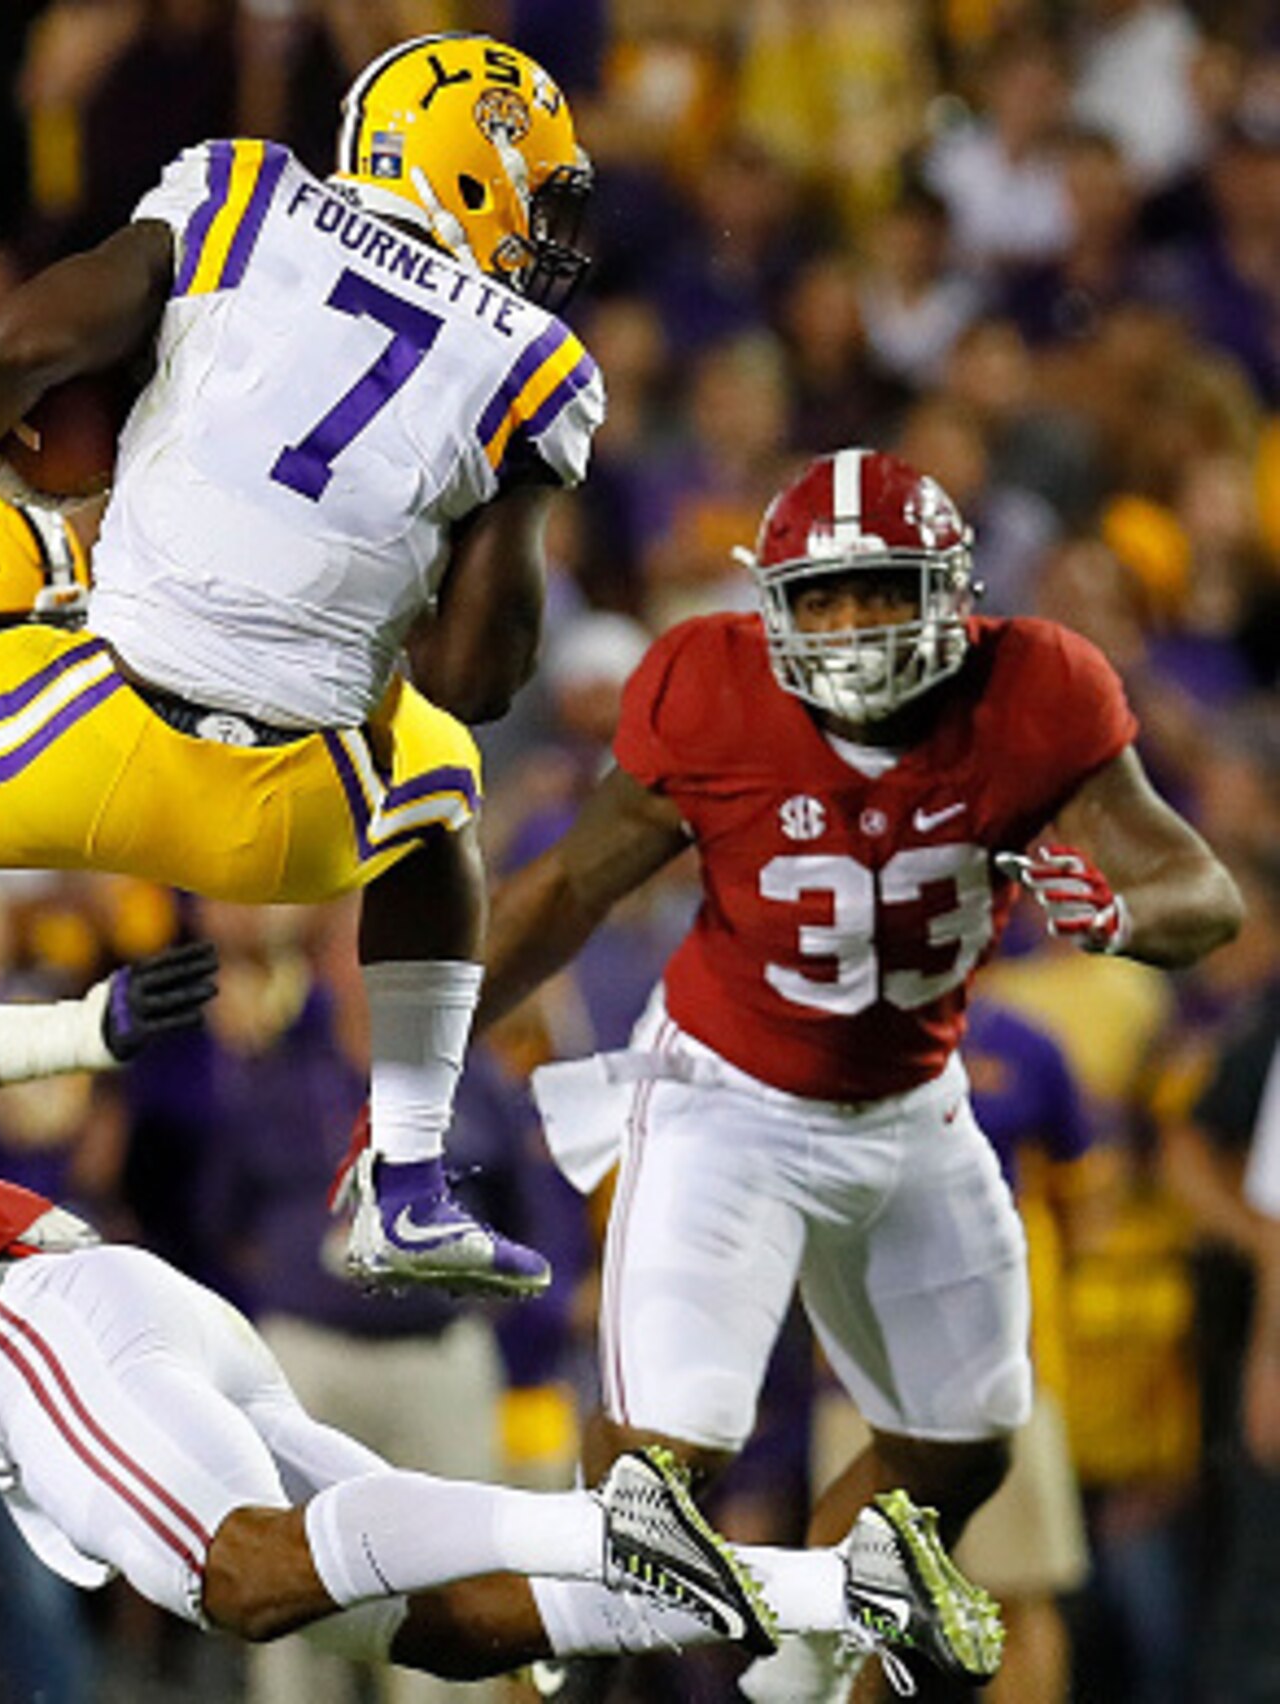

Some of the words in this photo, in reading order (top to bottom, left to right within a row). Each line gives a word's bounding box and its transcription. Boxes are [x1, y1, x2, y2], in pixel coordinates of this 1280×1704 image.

[286, 181, 527, 338] FOURNETTE
[269, 267, 447, 502] 7
[758, 842, 996, 1016] 33
